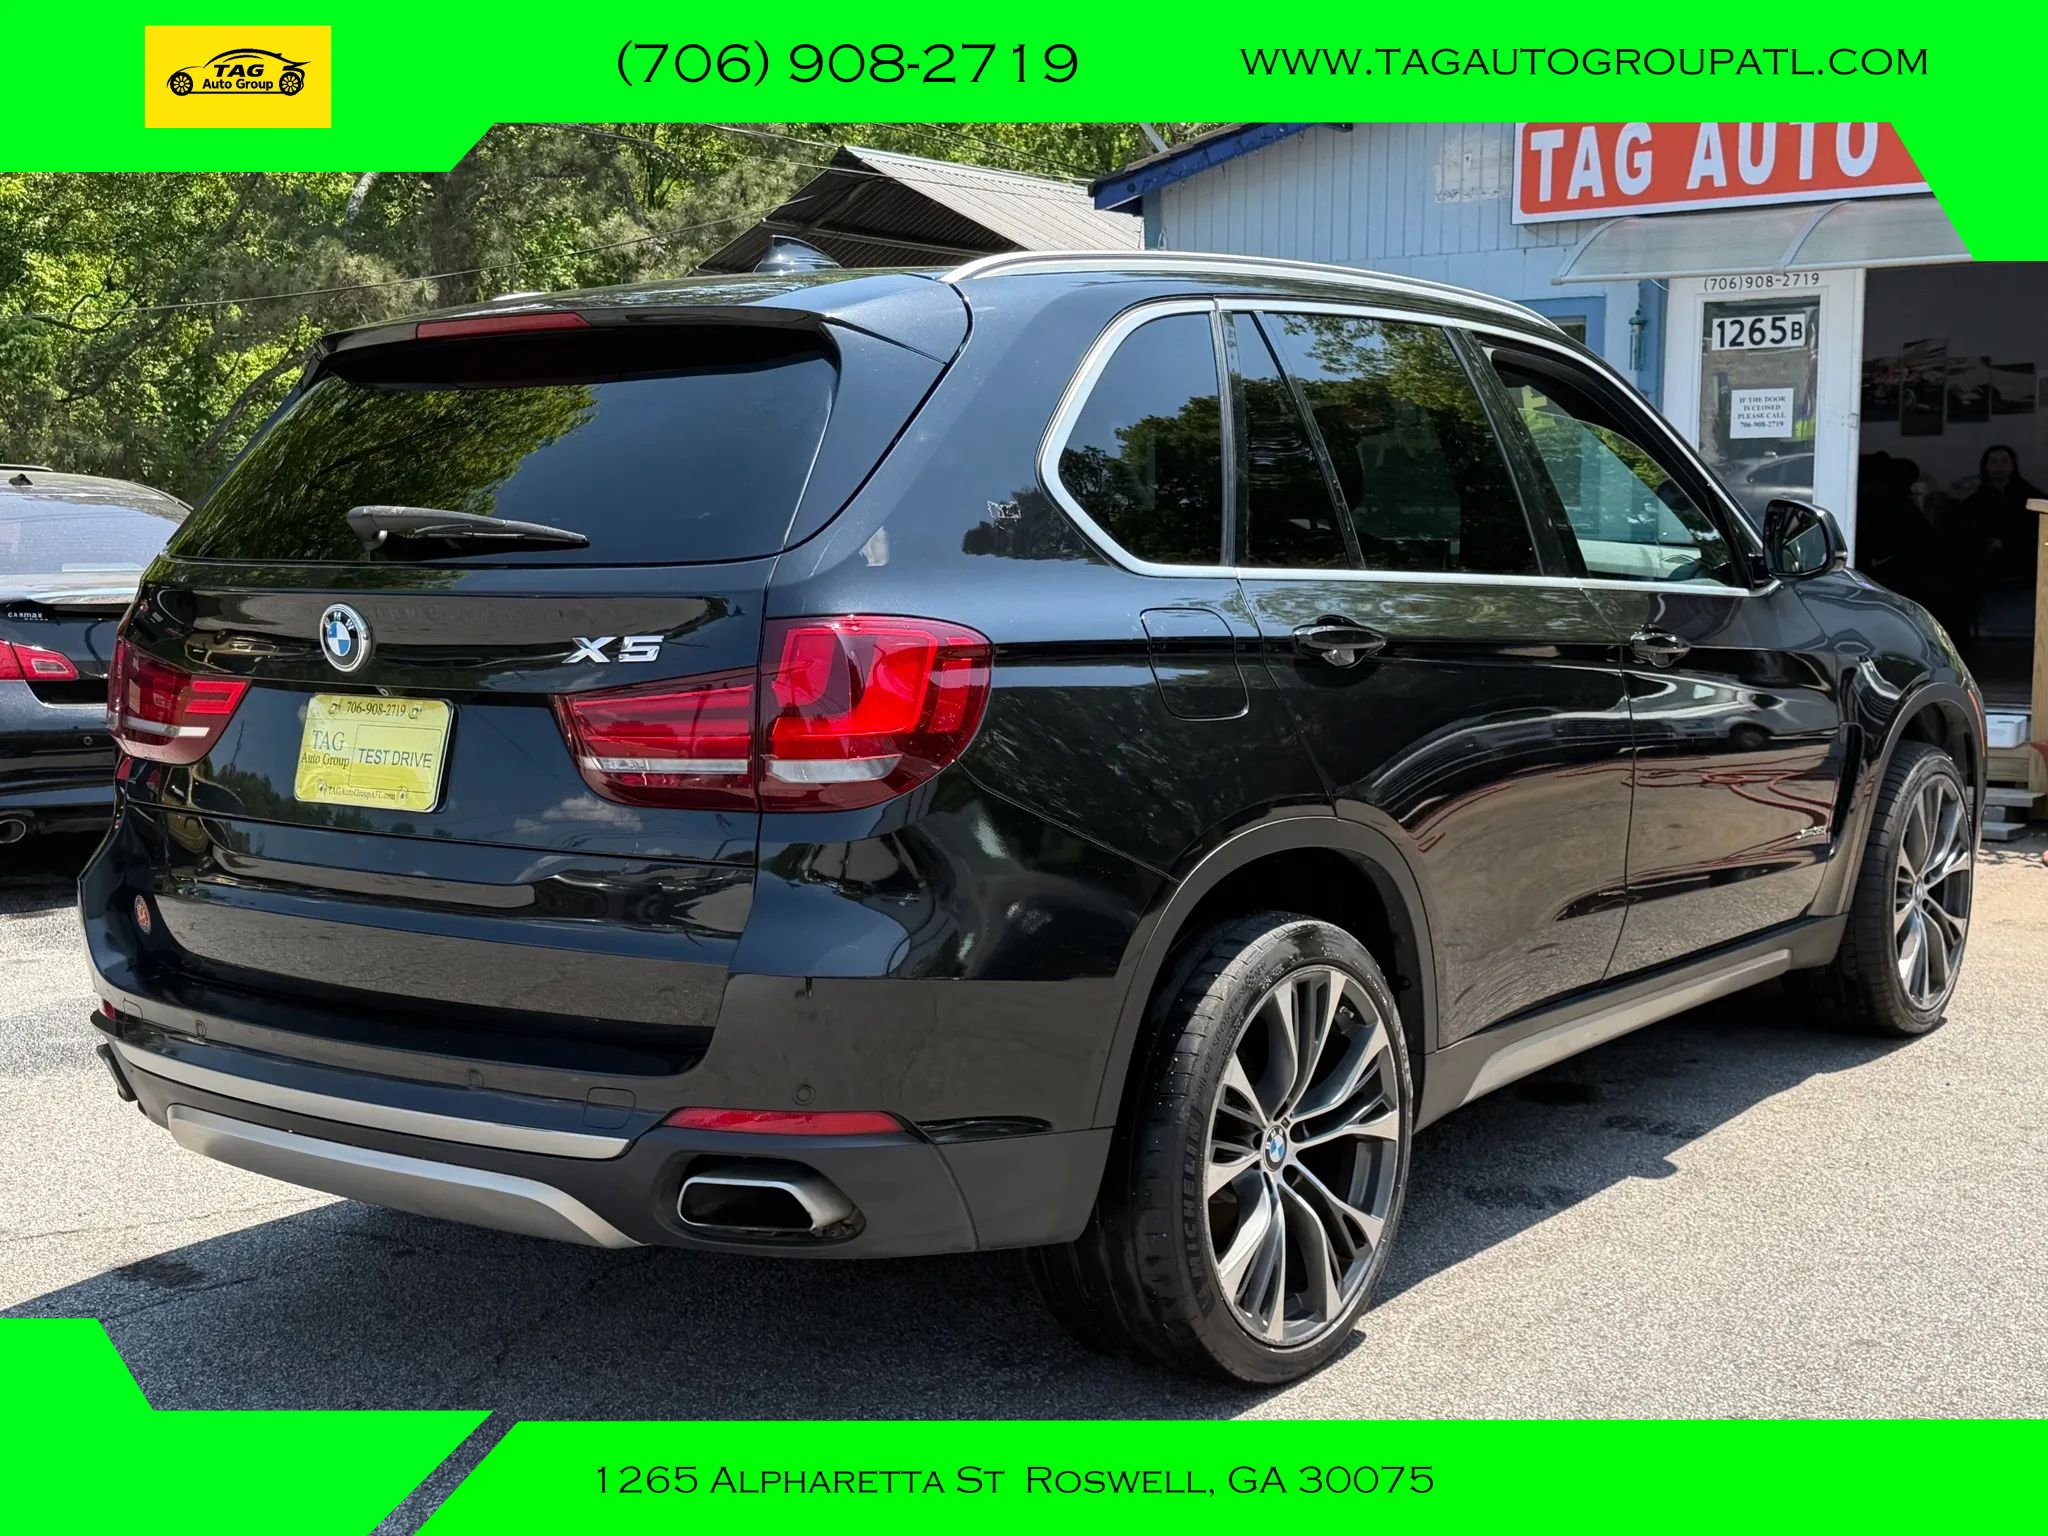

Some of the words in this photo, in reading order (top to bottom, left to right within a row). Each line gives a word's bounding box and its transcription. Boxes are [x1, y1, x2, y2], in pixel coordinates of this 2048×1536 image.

[1530, 122, 1653, 203] TAG
[1686, 122, 1879, 190] AUTO
[1704, 272, 1820, 291] (706)908-2719
[561, 635, 665, 664] X5
[346, 701, 407, 717] 706-908-2719
[312, 730, 345, 751] TAG
[301, 752, 321, 764] Auto
[322, 753, 350, 771] Group
[358, 748, 388, 765] TEST
[391, 749, 433, 768] DRIVE
